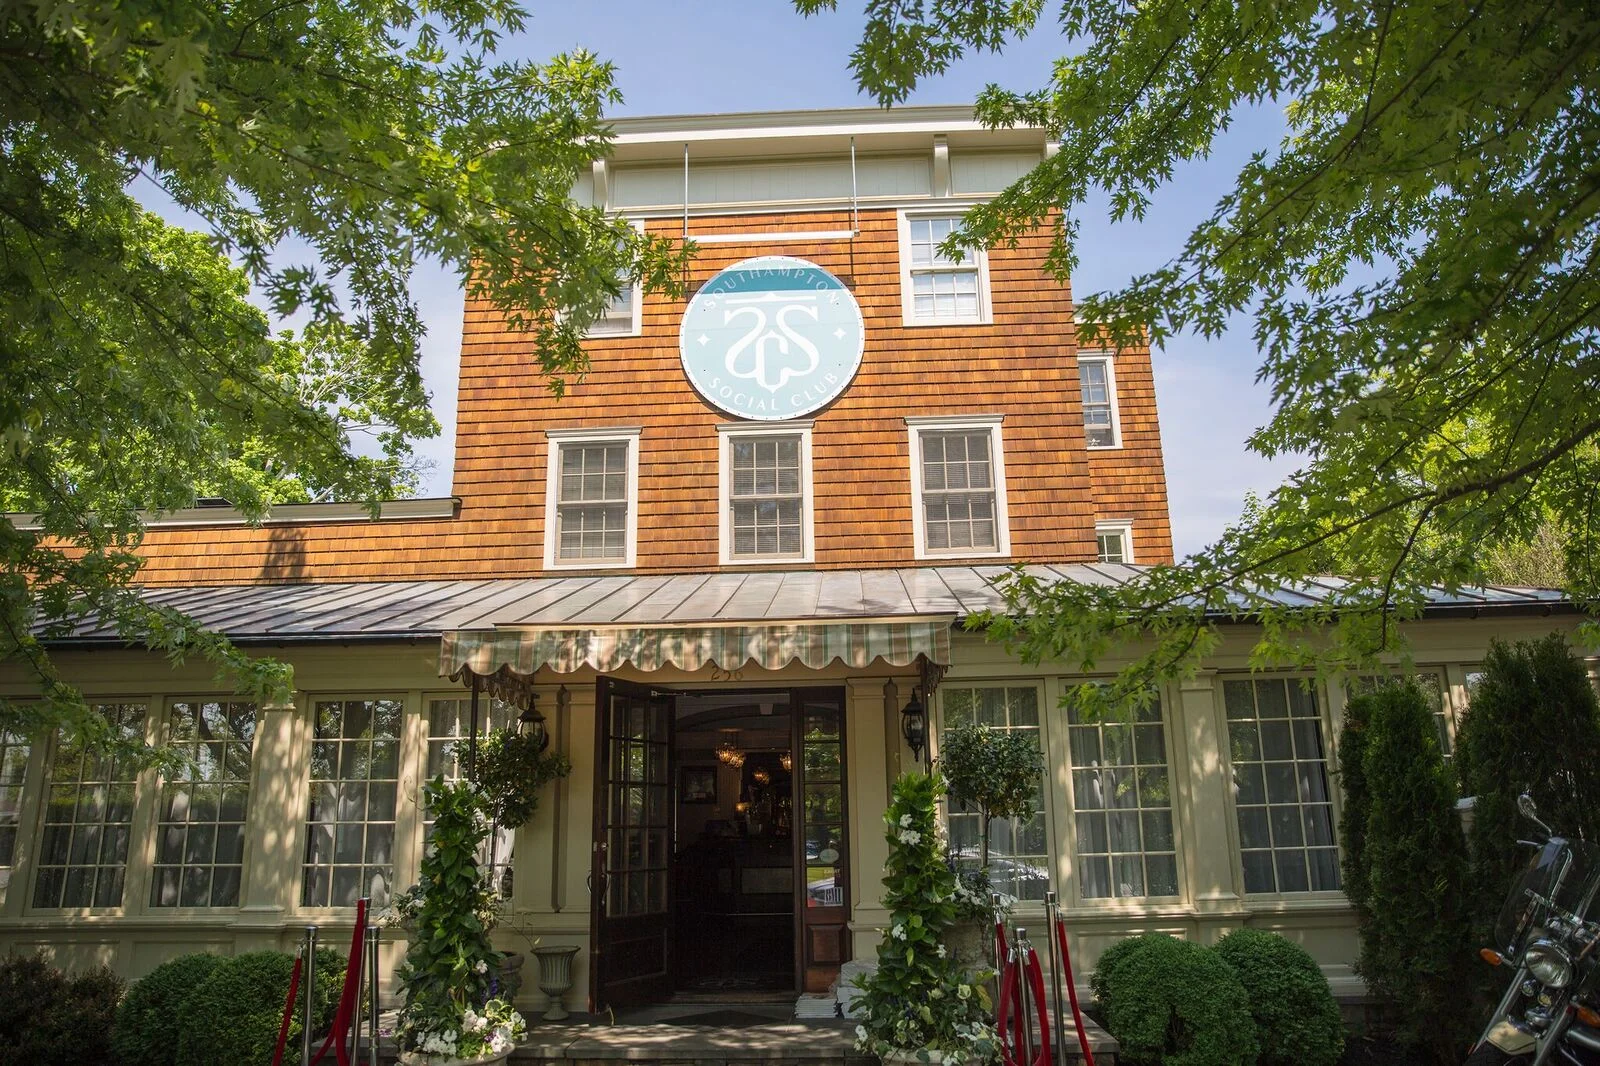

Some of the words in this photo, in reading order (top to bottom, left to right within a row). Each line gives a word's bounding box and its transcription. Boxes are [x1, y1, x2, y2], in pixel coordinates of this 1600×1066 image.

[703, 266, 840, 309] SOUTHAMPTON
[708, 377, 780, 411] SOCIAL
[790, 371, 839, 408] CLUB
